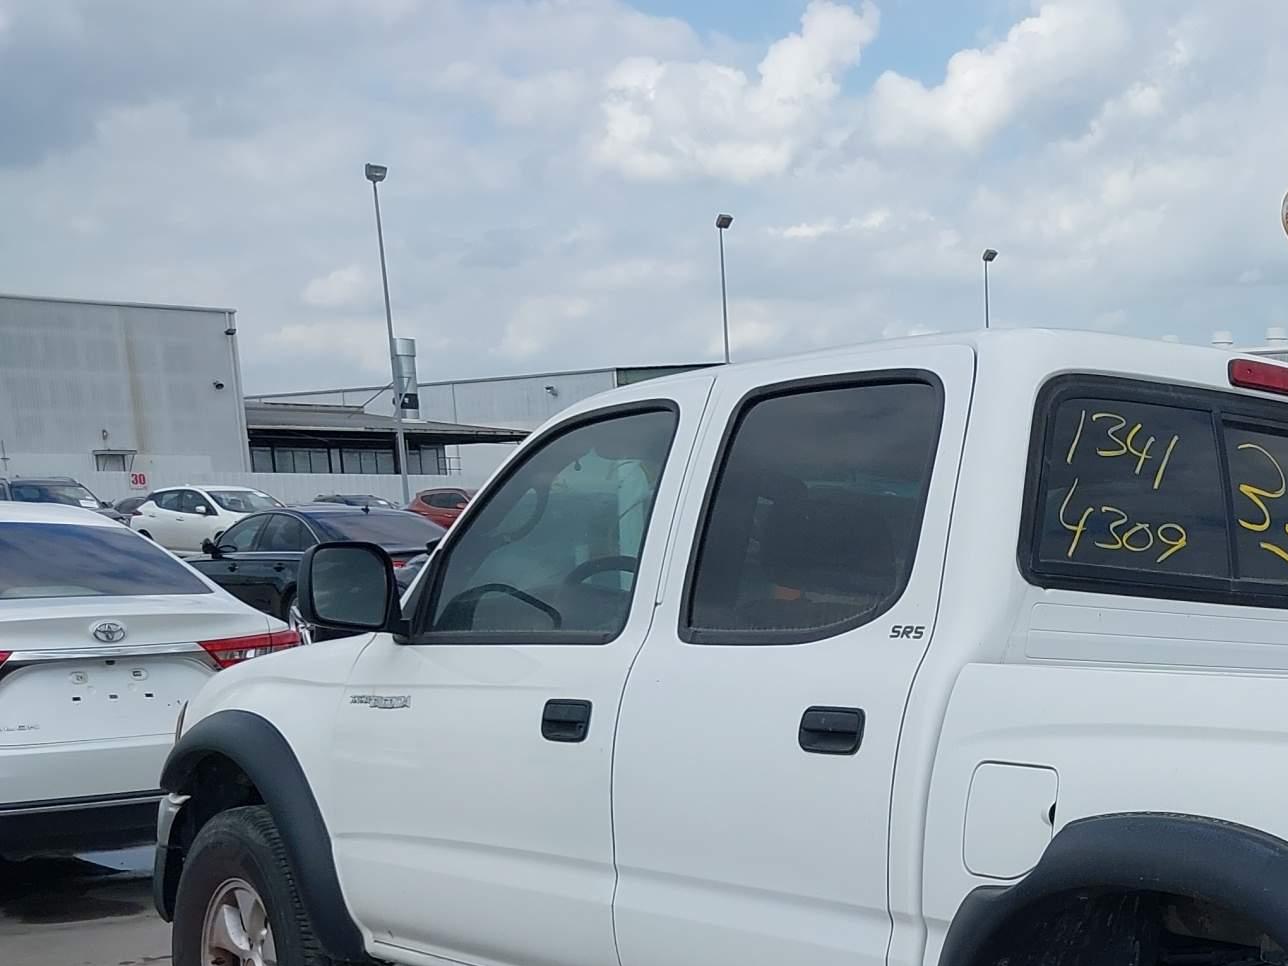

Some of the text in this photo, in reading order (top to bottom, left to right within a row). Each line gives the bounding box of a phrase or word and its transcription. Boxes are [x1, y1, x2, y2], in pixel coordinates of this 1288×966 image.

[131, 473, 146, 486] 30
[1066, 410, 1179, 490] 1341
[1059, 478, 1187, 563] 4309
